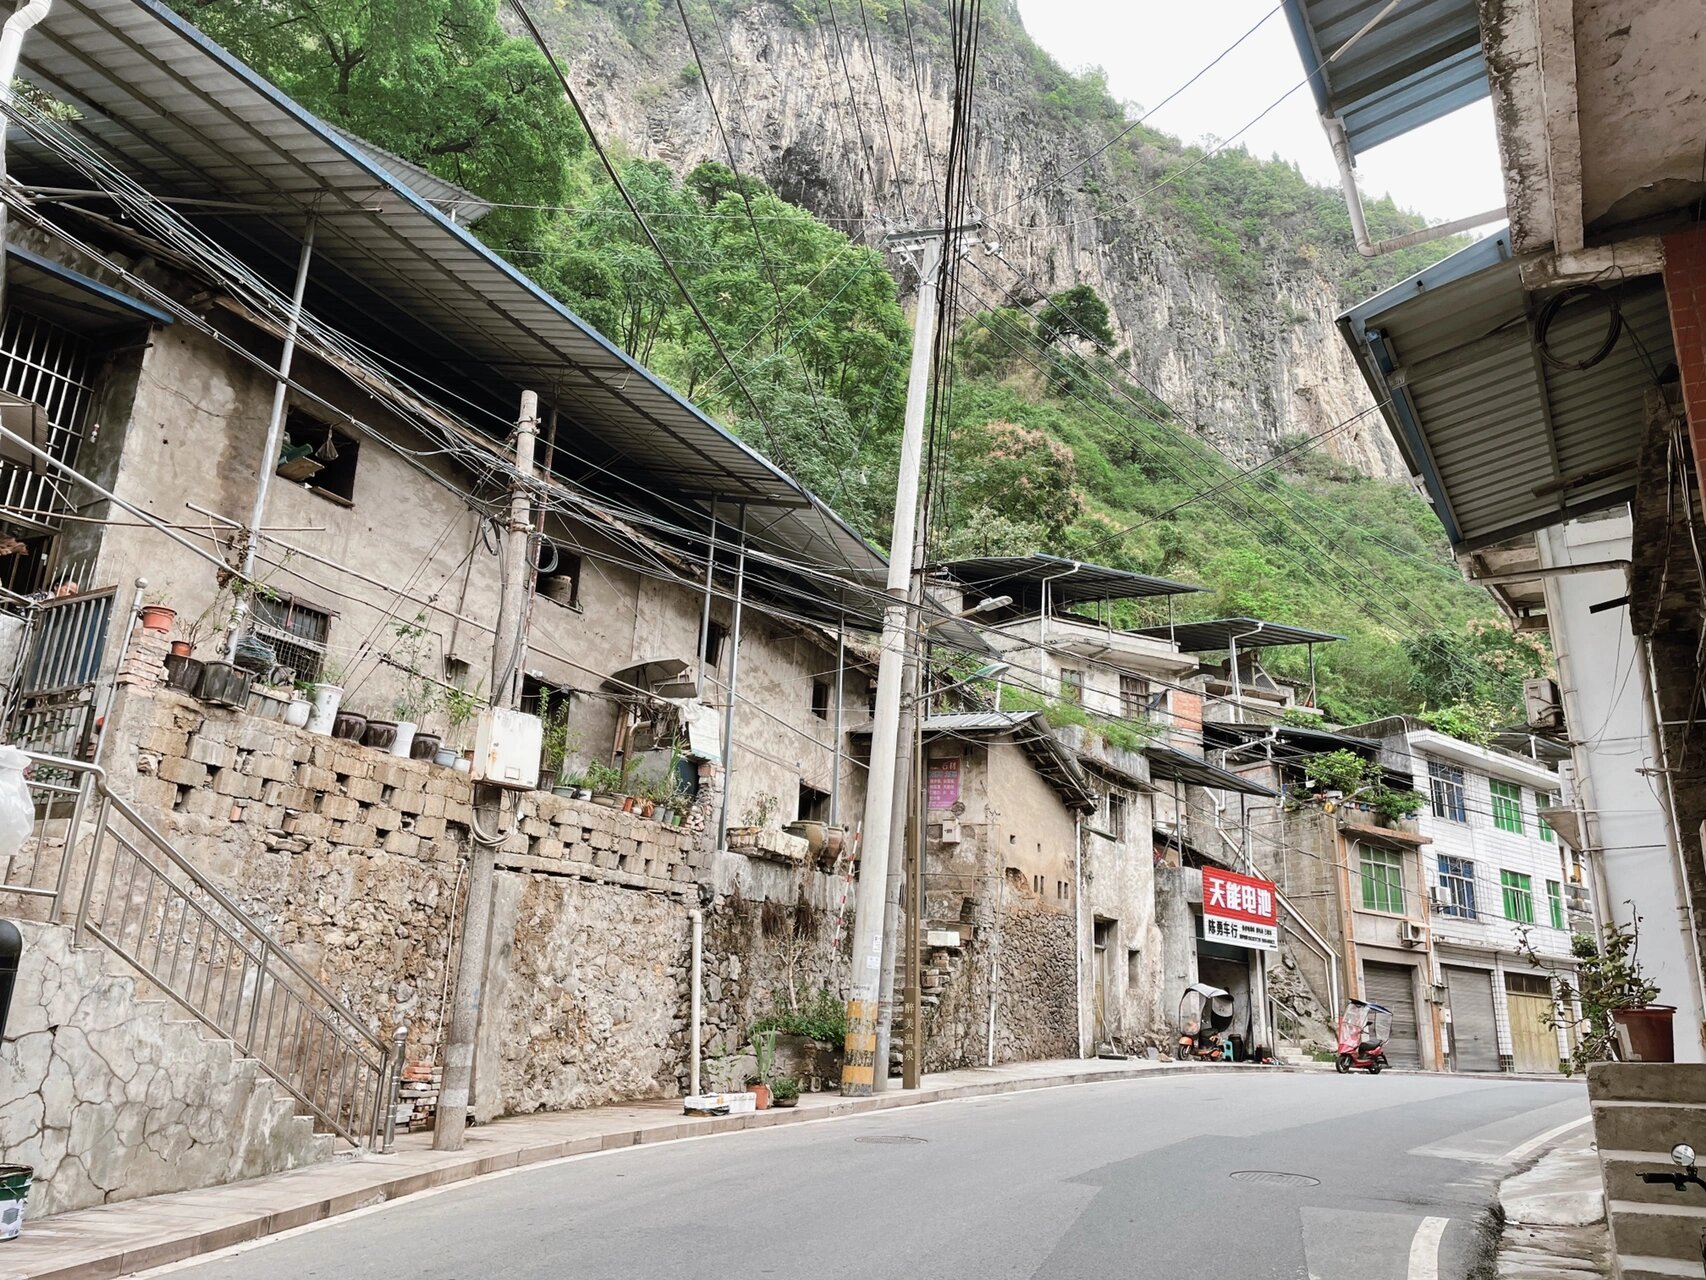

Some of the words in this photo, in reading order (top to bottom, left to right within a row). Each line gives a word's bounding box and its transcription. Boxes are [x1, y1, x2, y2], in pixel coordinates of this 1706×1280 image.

[1208, 878, 1271, 917] 天能电池
[1208, 919, 1238, 938] 陈勇车行
[904, 1002, 915, 1061] 醉美温泉
